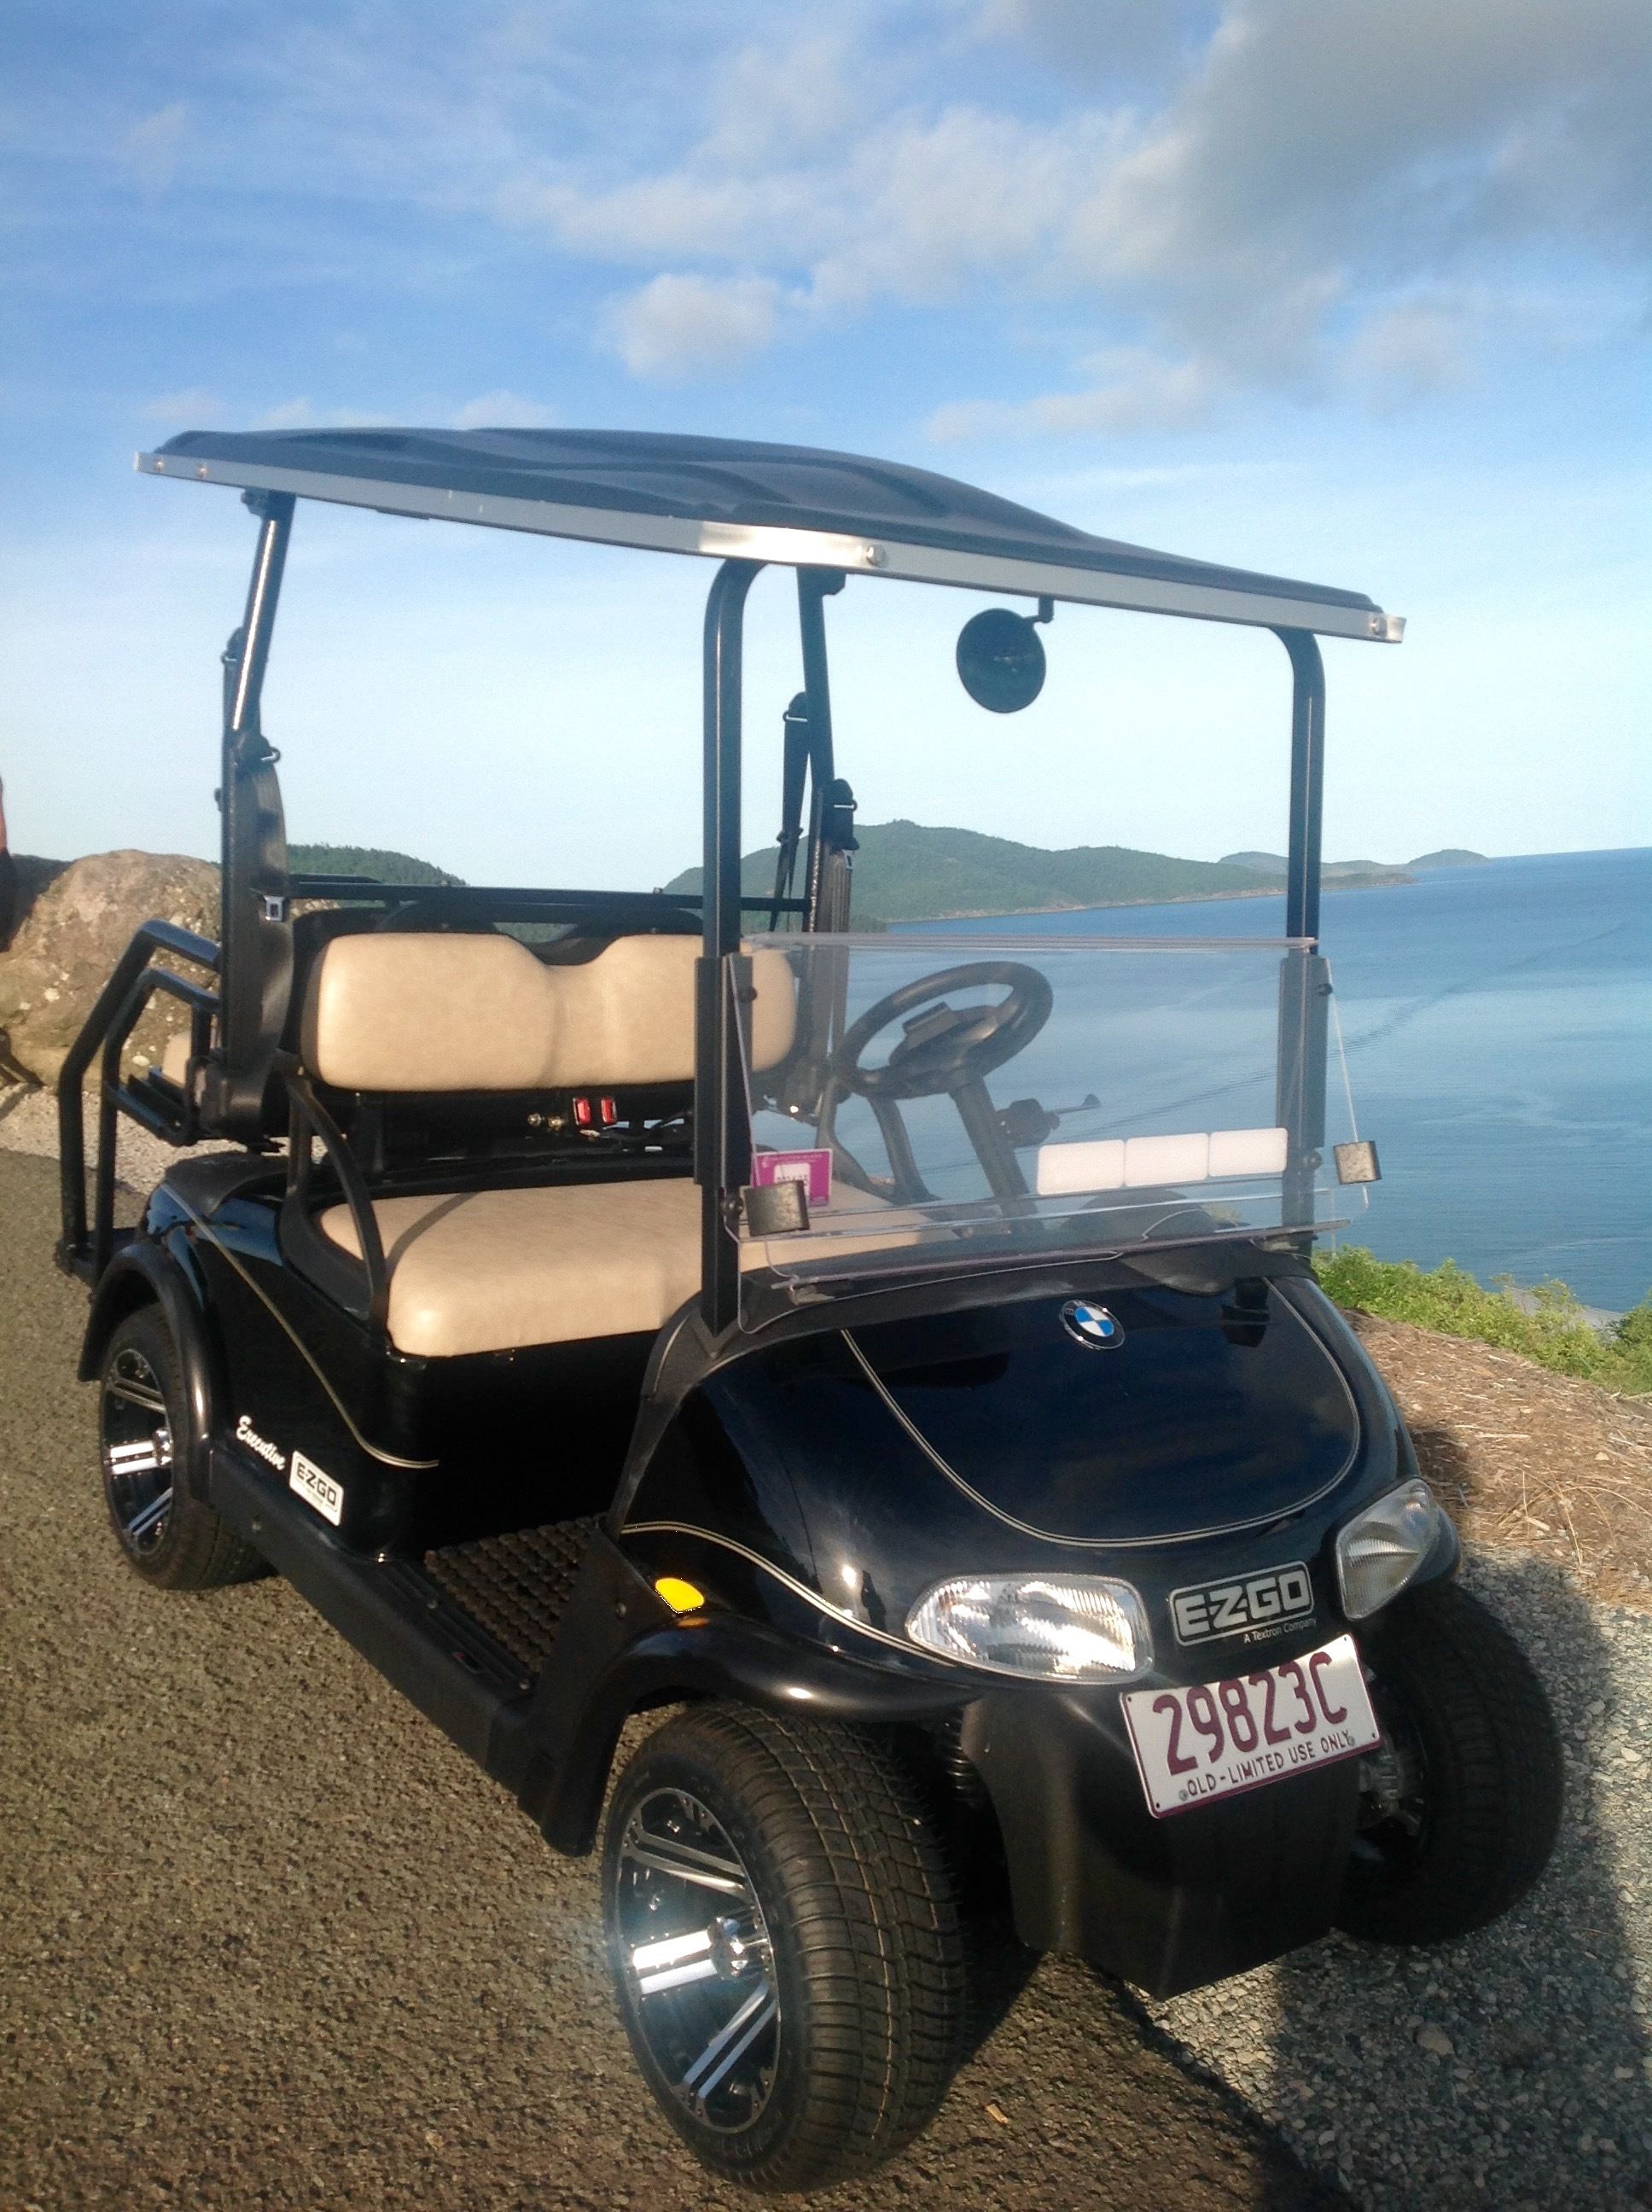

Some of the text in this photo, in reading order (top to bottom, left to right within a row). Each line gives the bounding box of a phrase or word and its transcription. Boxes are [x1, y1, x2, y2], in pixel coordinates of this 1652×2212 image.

[1243, 1618, 1317, 1644] A Textron Company
[1153, 1651, 1347, 1777] 29823C
[1288, 1742, 1316, 1764] USE
[1320, 1730, 1352, 1753] ONLY
